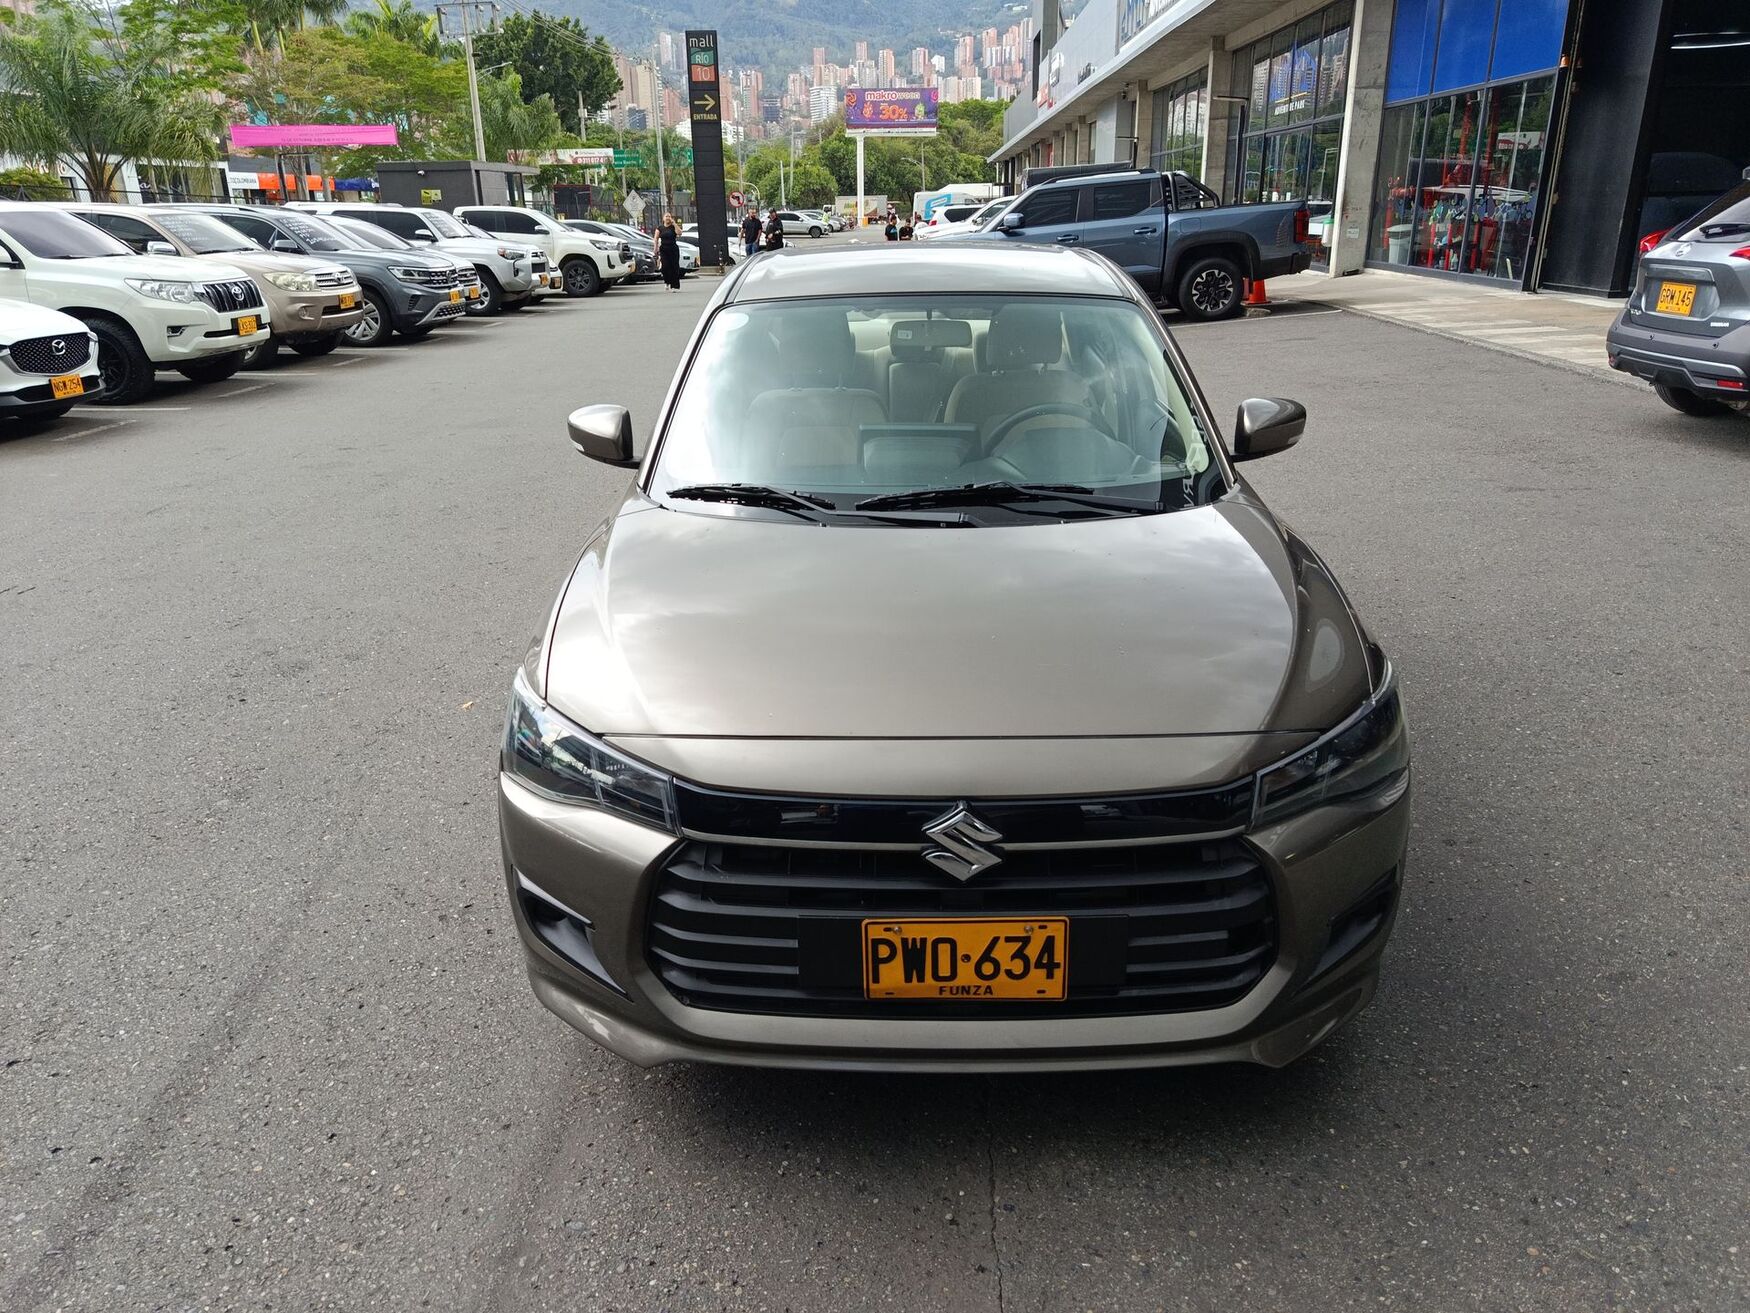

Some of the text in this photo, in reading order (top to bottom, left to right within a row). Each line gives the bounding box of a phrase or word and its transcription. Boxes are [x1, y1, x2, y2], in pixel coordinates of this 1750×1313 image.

[689, 34, 714, 47] mall
[697, 67, 710, 80] 10
[880, 104, 908, 119] 30%
[939, 985, 993, 996] FUNZA
